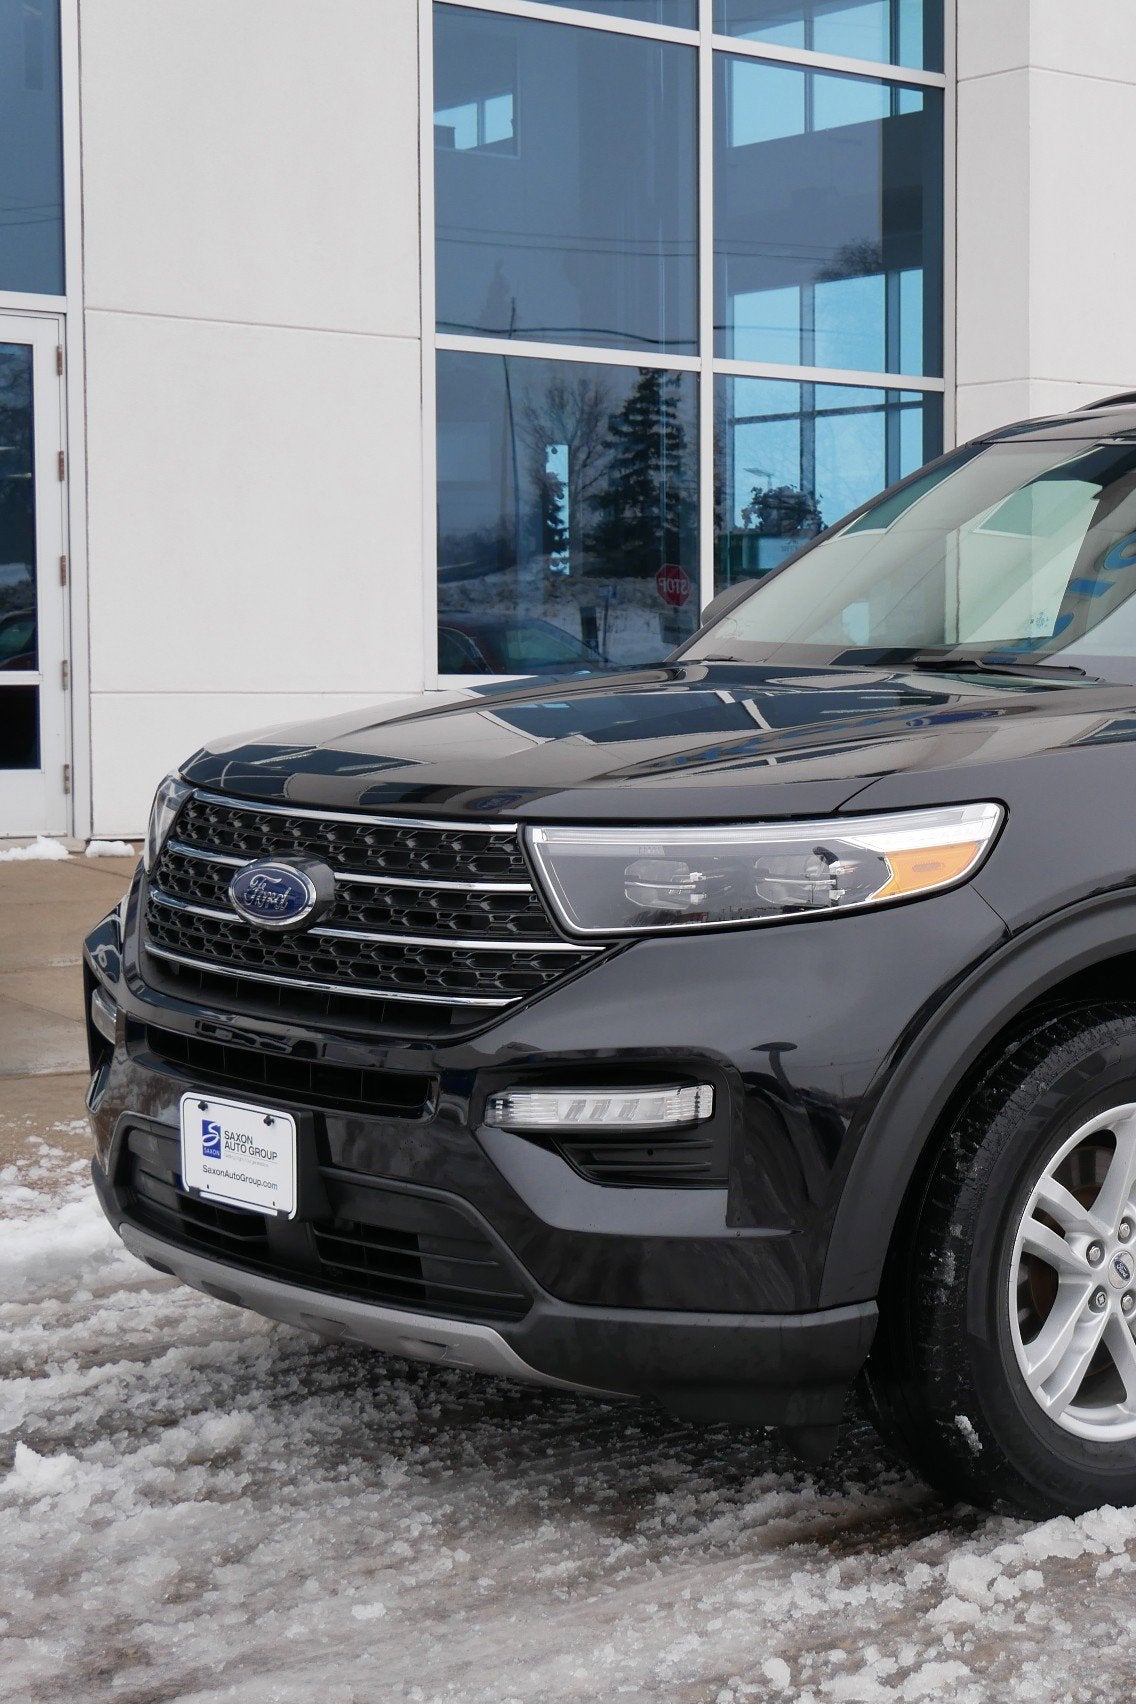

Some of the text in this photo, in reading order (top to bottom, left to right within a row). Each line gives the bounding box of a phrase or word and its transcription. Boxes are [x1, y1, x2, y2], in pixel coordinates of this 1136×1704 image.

[243, 873, 292, 911] Ford
[224, 1130, 253, 1145] SAXON
[203, 1147, 220, 1156] SAXON
[224, 1140, 278, 1160] AUTO GROUP
[202, 1164, 278, 1190] SaxonAutoGroup.com
